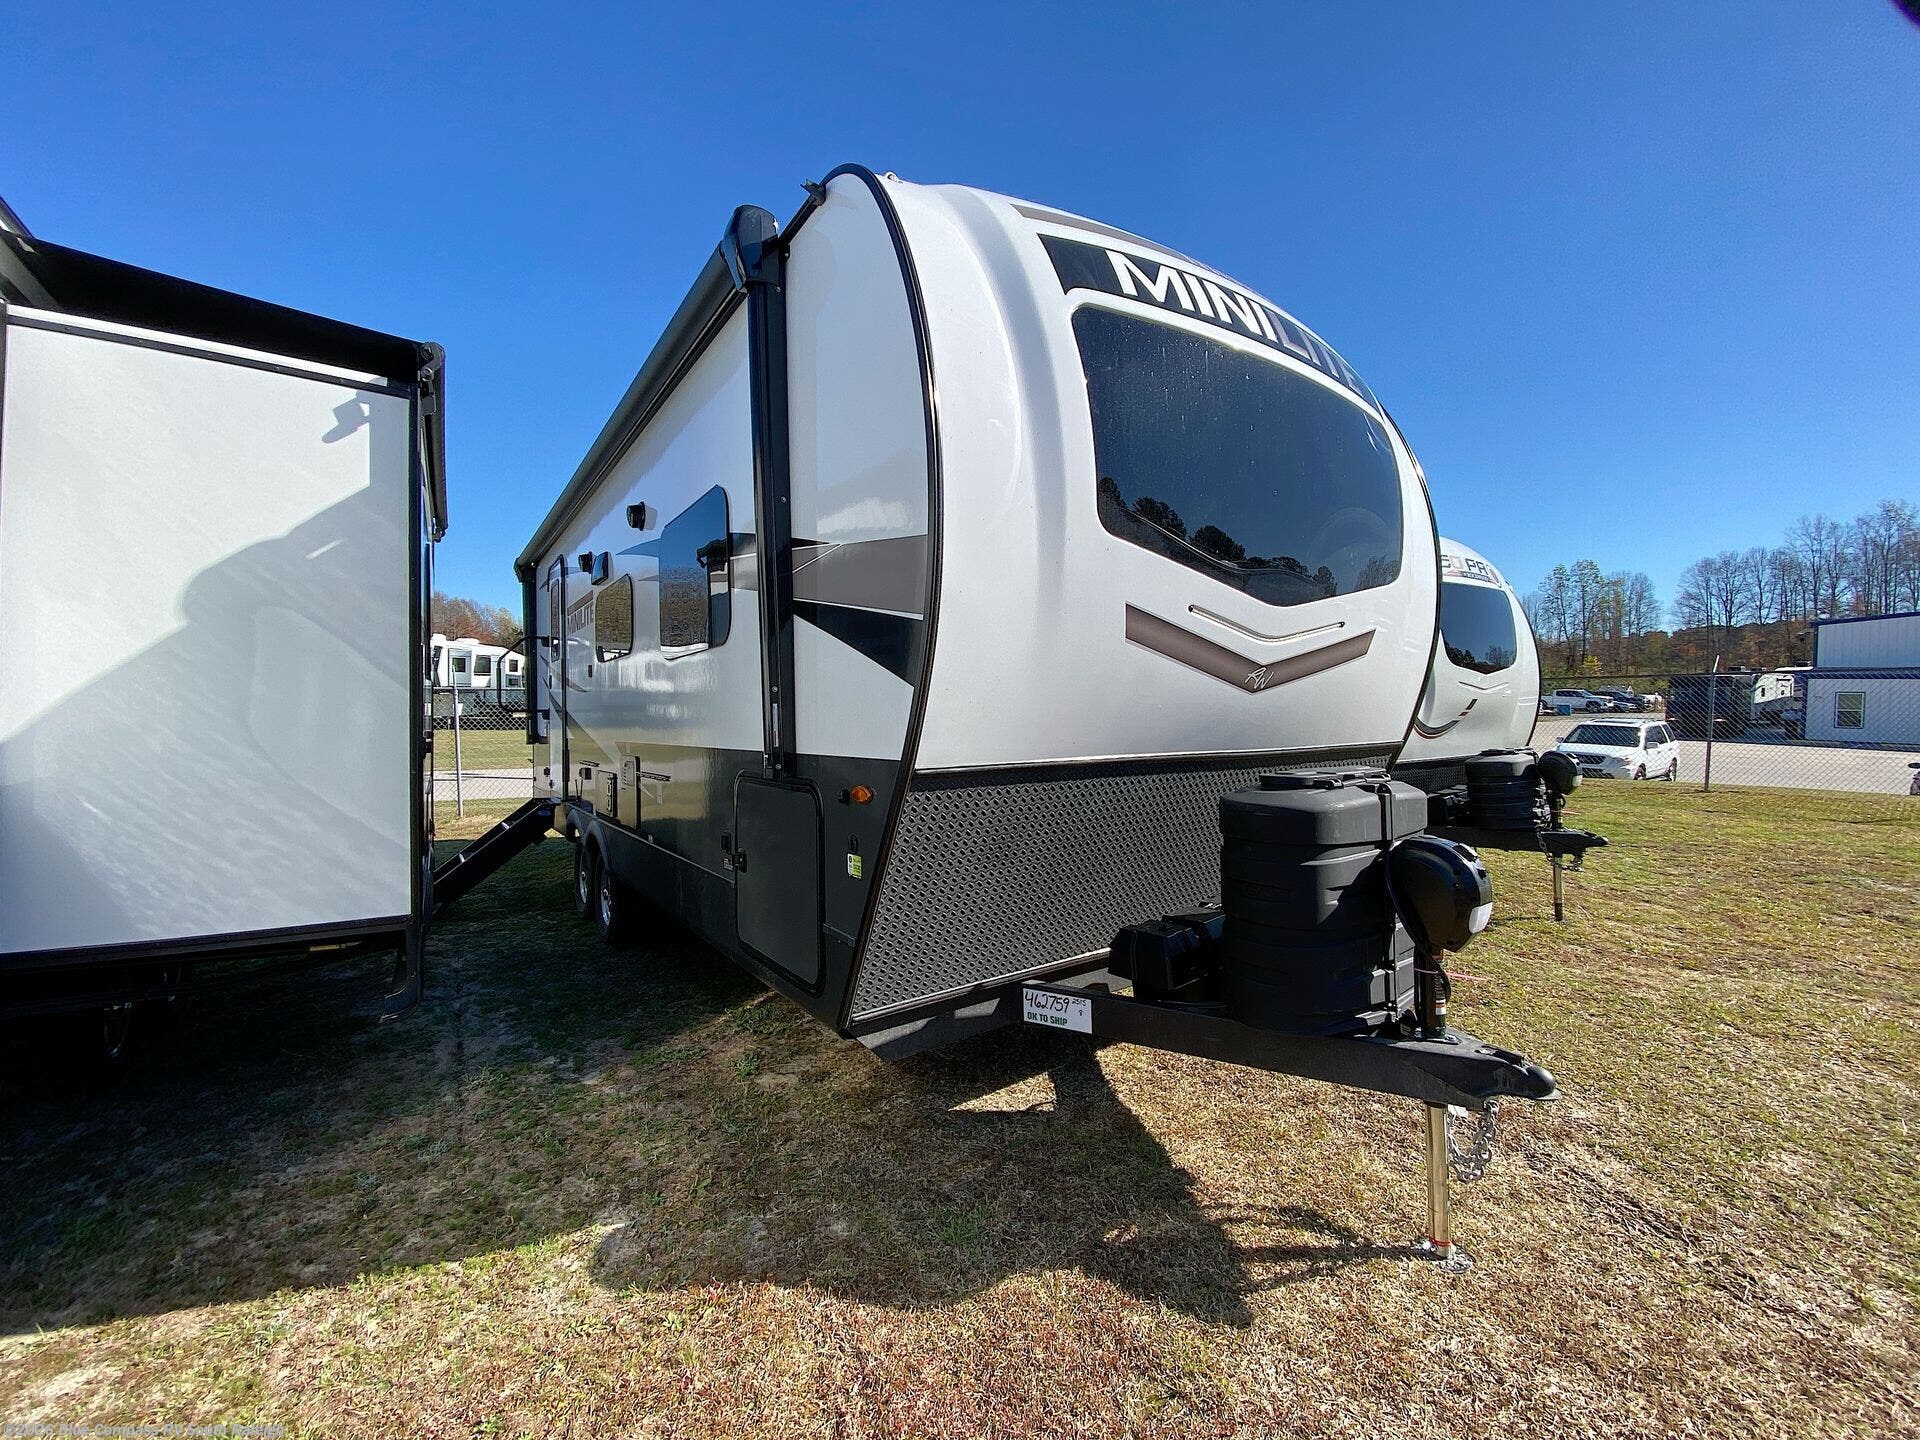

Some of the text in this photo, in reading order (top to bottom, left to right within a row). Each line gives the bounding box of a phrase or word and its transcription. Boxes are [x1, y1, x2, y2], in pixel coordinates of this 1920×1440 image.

[1104, 248, 1364, 398] MINILITE
[1024, 990, 1070, 1013] 462759
[1027, 1011, 1068, 1026] OK TO SHIP
